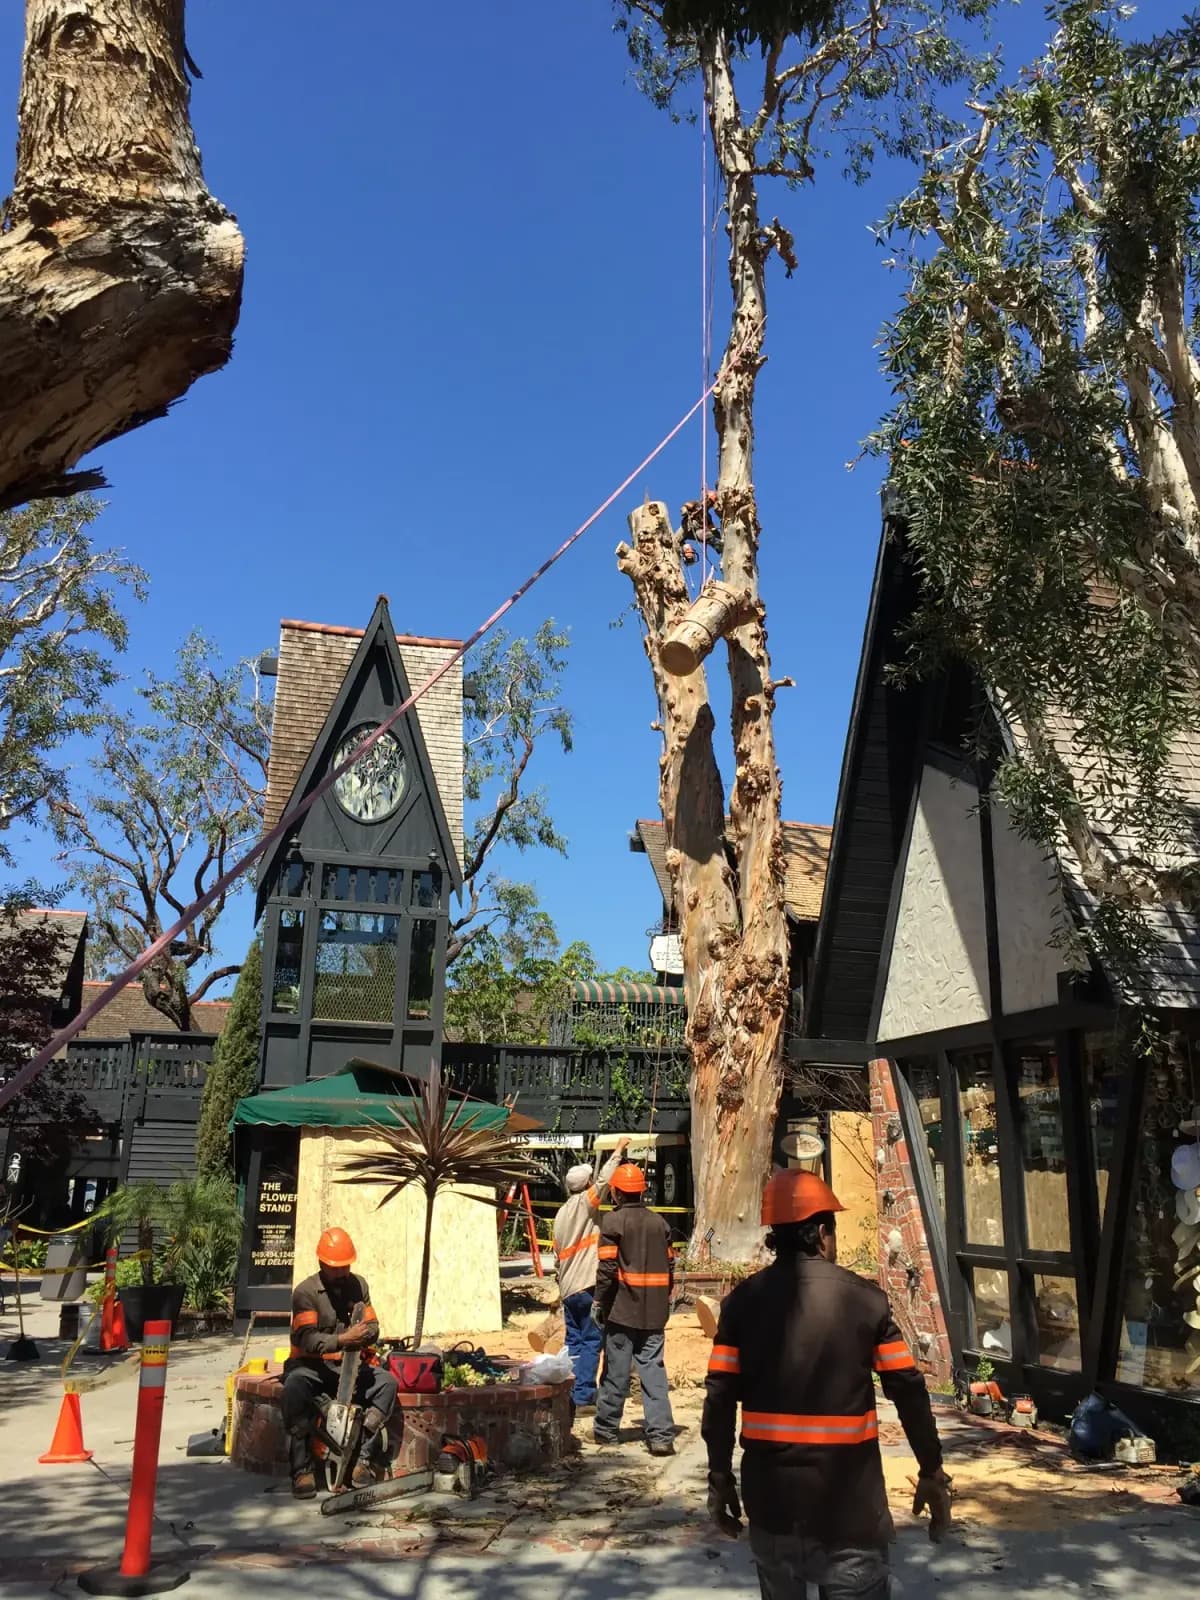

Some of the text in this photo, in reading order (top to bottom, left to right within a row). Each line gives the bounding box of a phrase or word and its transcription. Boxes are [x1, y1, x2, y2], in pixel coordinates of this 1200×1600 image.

[262, 1182, 281, 1191] THE
[259, 1203, 292, 1213] STAND
[254, 1258, 295, 1266] WE DELIVE
